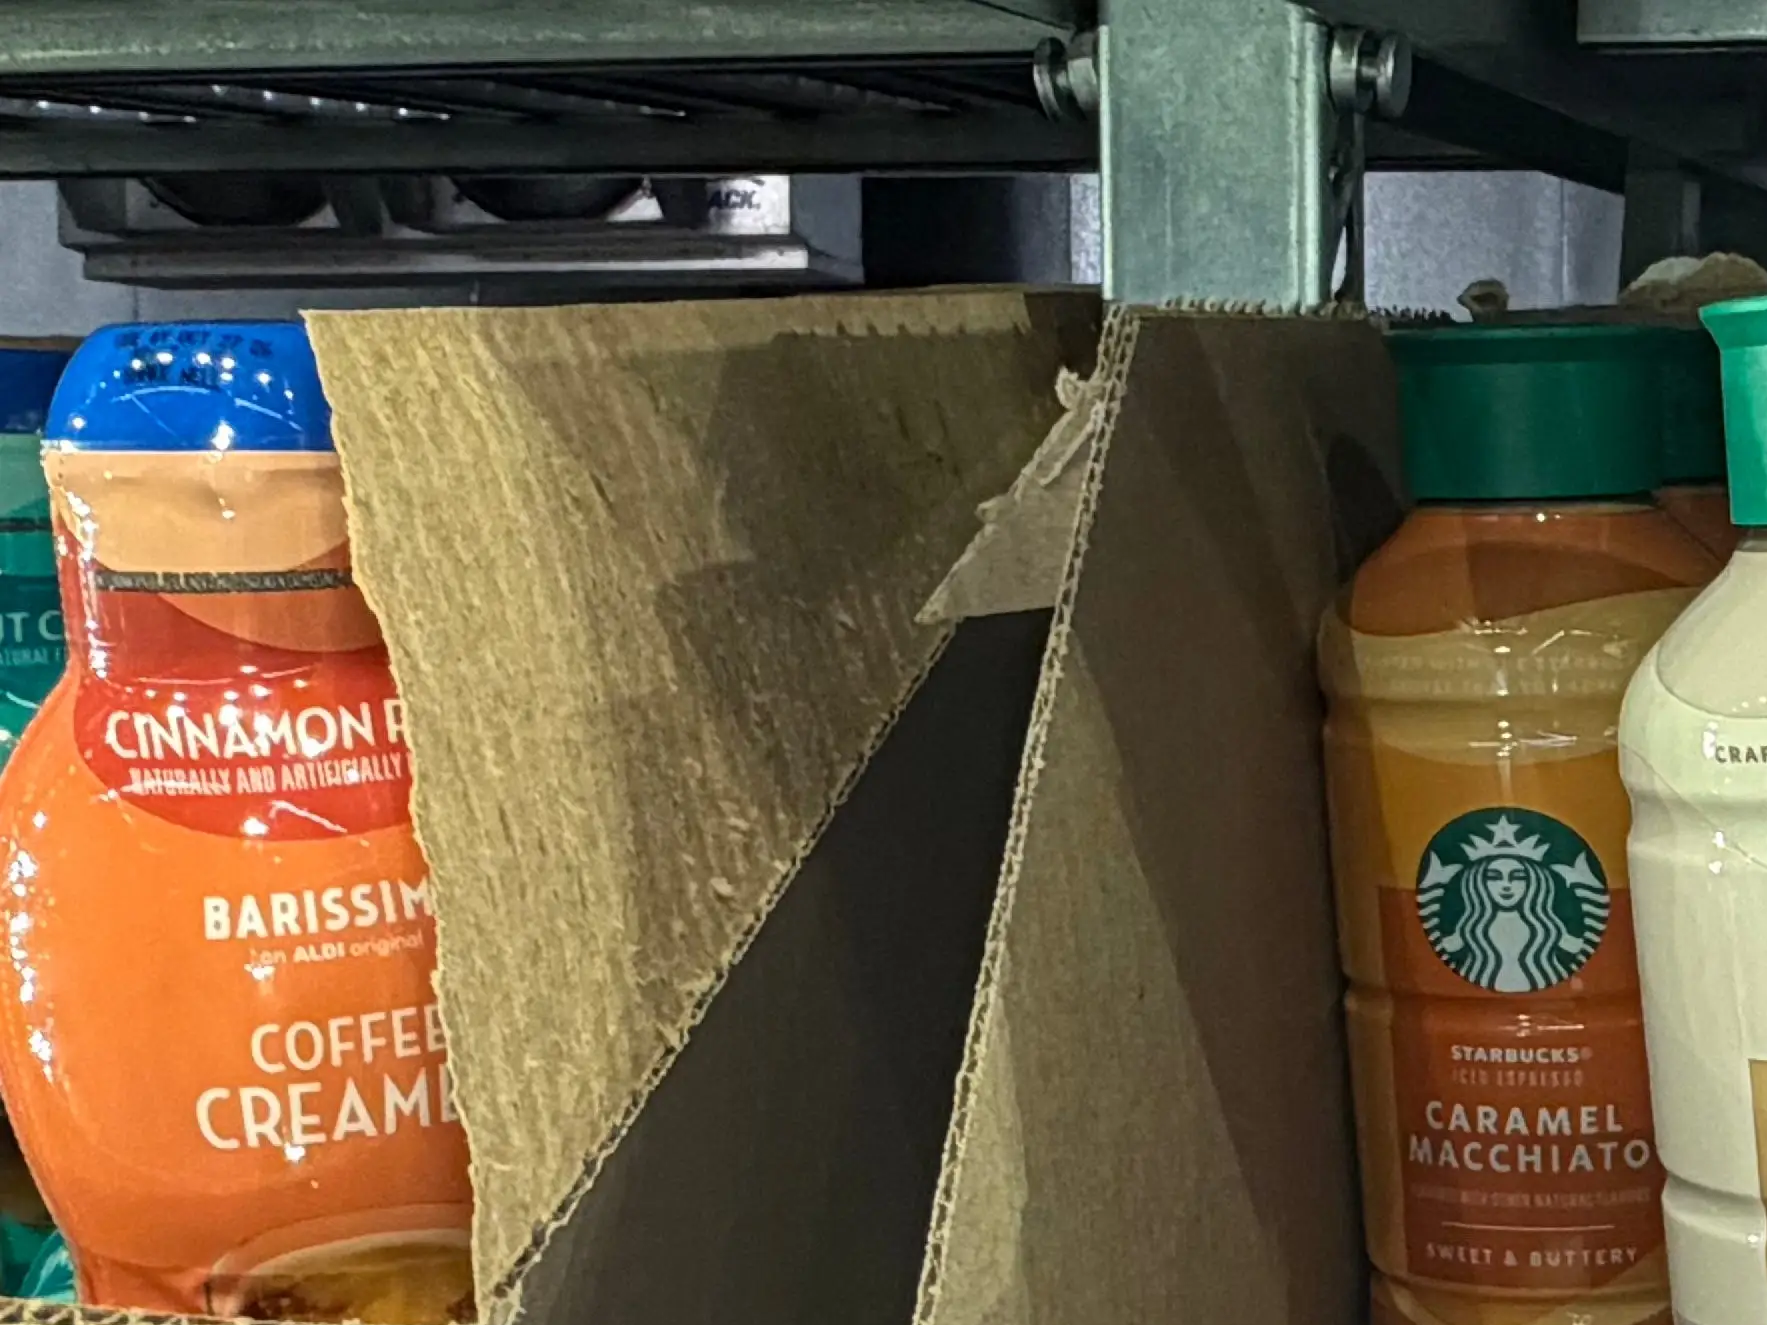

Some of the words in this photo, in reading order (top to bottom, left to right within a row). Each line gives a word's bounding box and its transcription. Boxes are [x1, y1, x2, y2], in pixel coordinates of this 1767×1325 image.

[104, 701, 376, 761] CINNAMON
[236, 764, 277, 793] AND
[281, 752, 402, 791] ARTIFICIALLY
[293, 942, 345, 963] ALDI
[348, 929, 425, 959] original
[250, 1002, 449, 1074] COFFEE
[1425, 1101, 1624, 1137] CARAMEL
[1408, 1133, 1651, 1174] MACCHIATO
[1426, 1243, 1493, 1266] SWEET
[1529, 1246, 1638, 1268] BUTTERY
